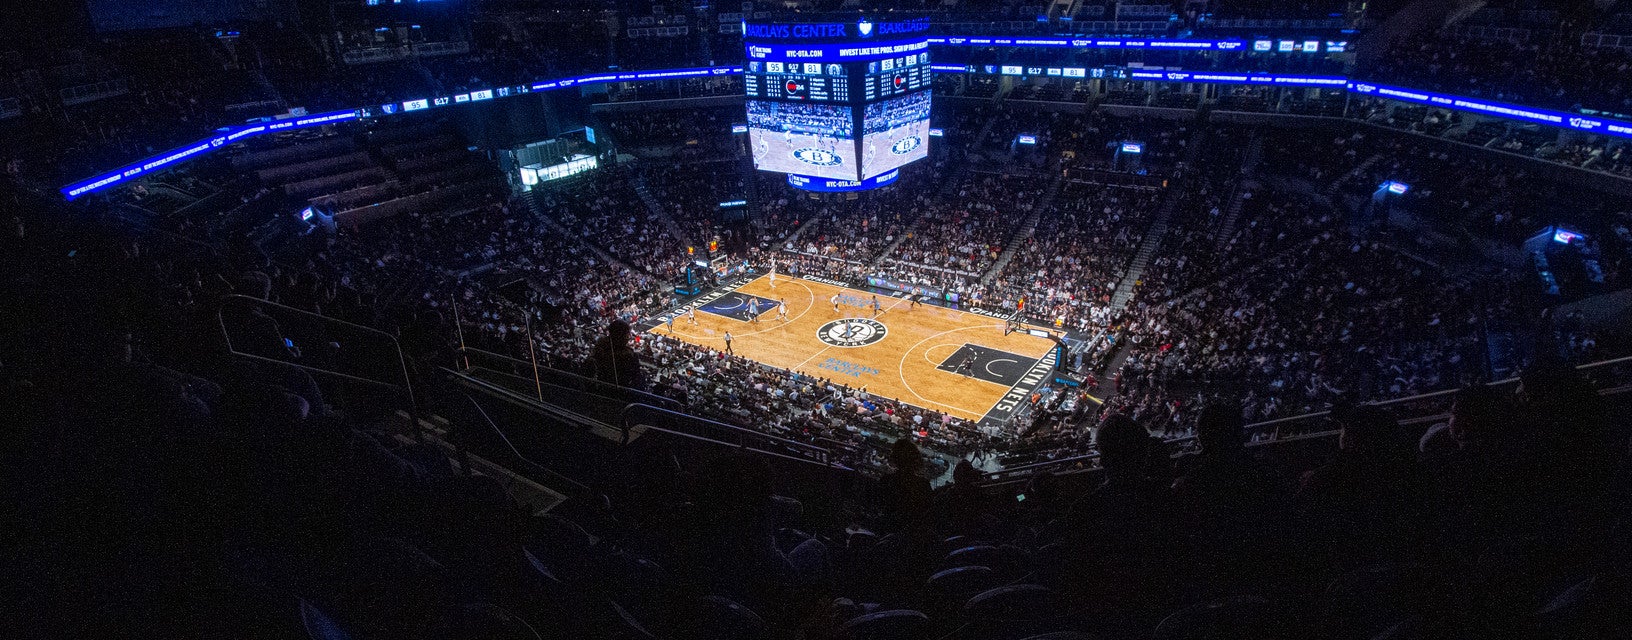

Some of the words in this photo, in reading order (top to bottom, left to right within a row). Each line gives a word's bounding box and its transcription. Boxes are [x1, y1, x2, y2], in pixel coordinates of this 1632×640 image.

[746, 24, 790, 38] BARCLAYS
[793, 23, 847, 37] CENTER
[840, 49, 858, 57] INVEST
[859, 48, 870, 56] LIKE
[870, 47, 879, 55] THE
[770, 63, 780, 72] 95
[807, 64, 817, 73] 81
[411, 101, 421, 109] 95
[996, 386, 1030, 413] NETS
